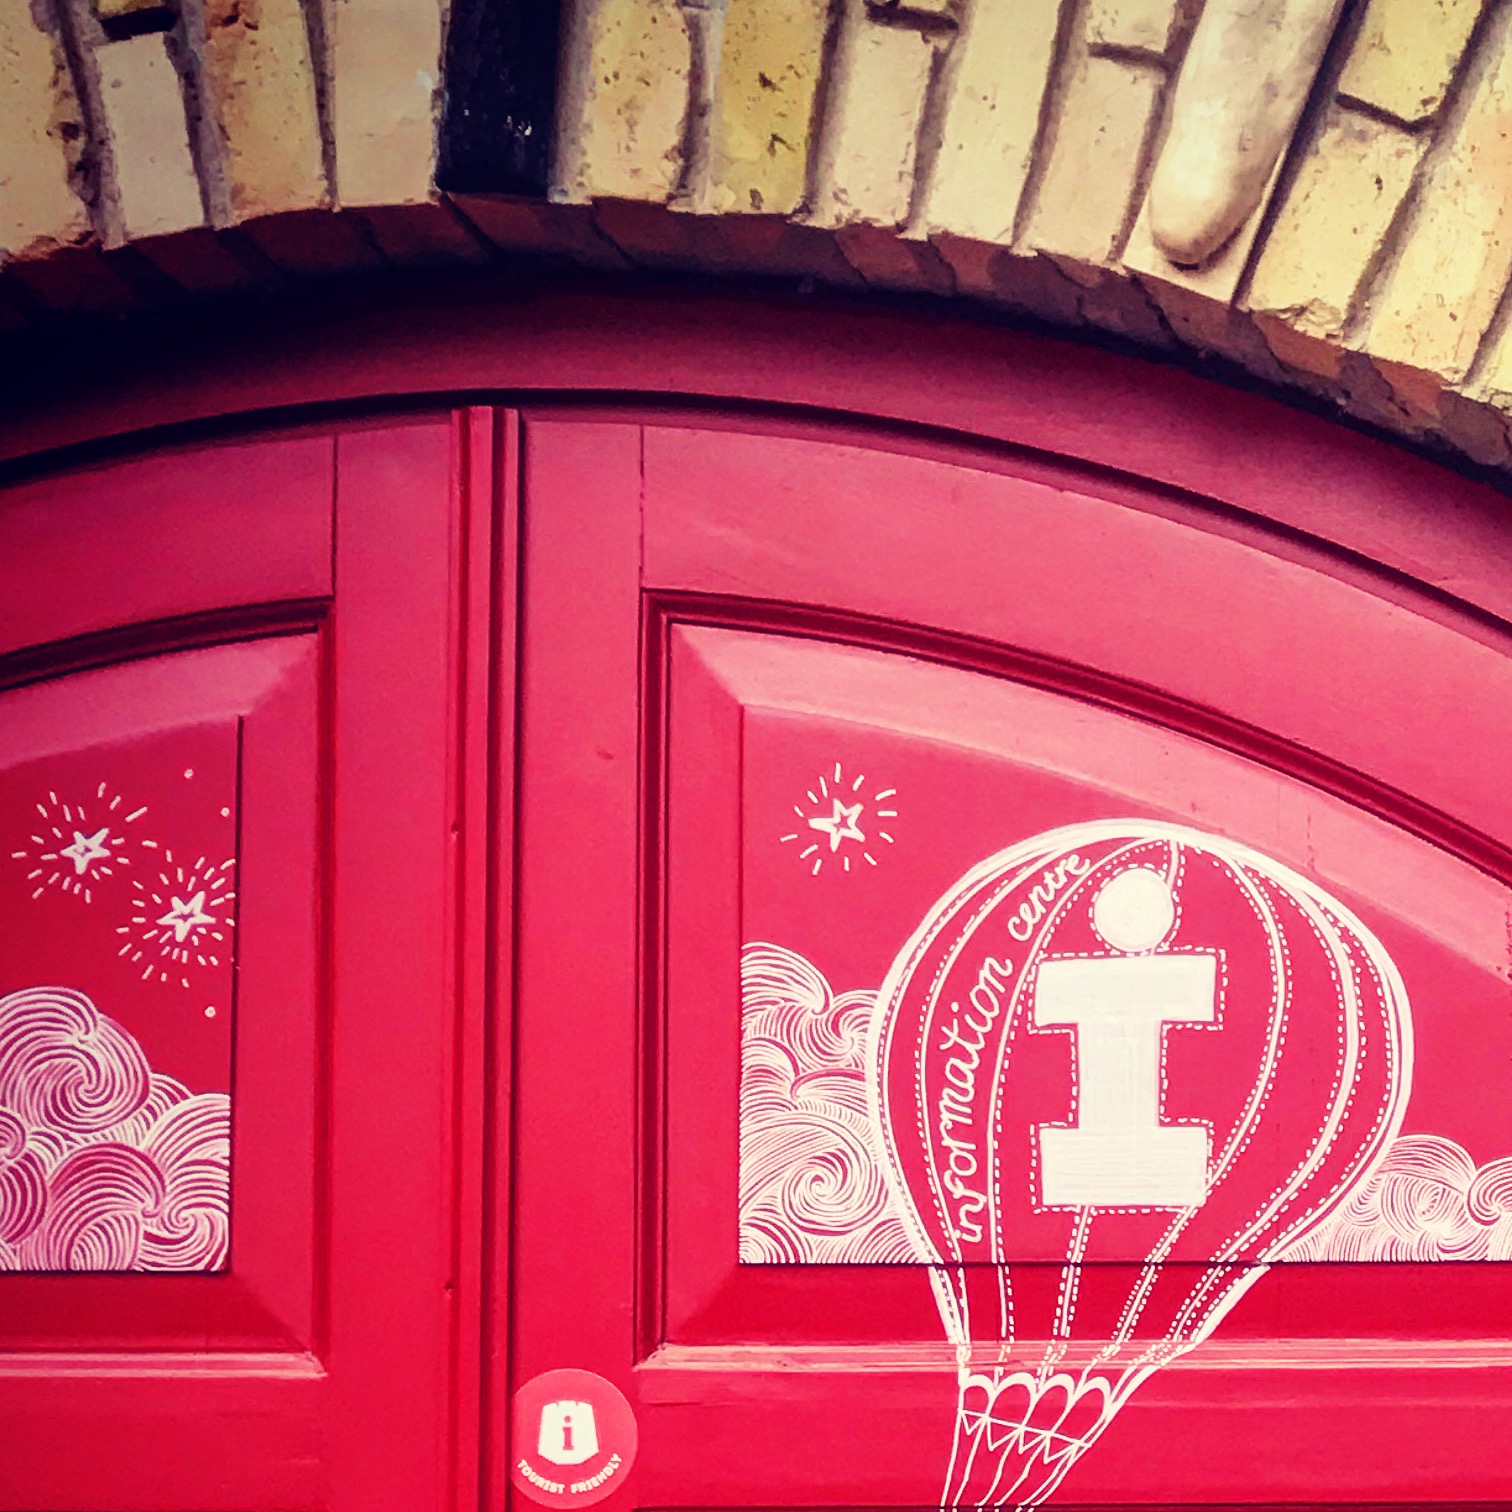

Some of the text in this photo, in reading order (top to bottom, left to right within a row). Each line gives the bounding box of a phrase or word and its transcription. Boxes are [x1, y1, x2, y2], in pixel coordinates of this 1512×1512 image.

[938, 853, 1091, 1244] information centre
[517, 1452, 623, 1494] TOURIST FRIENDLY
